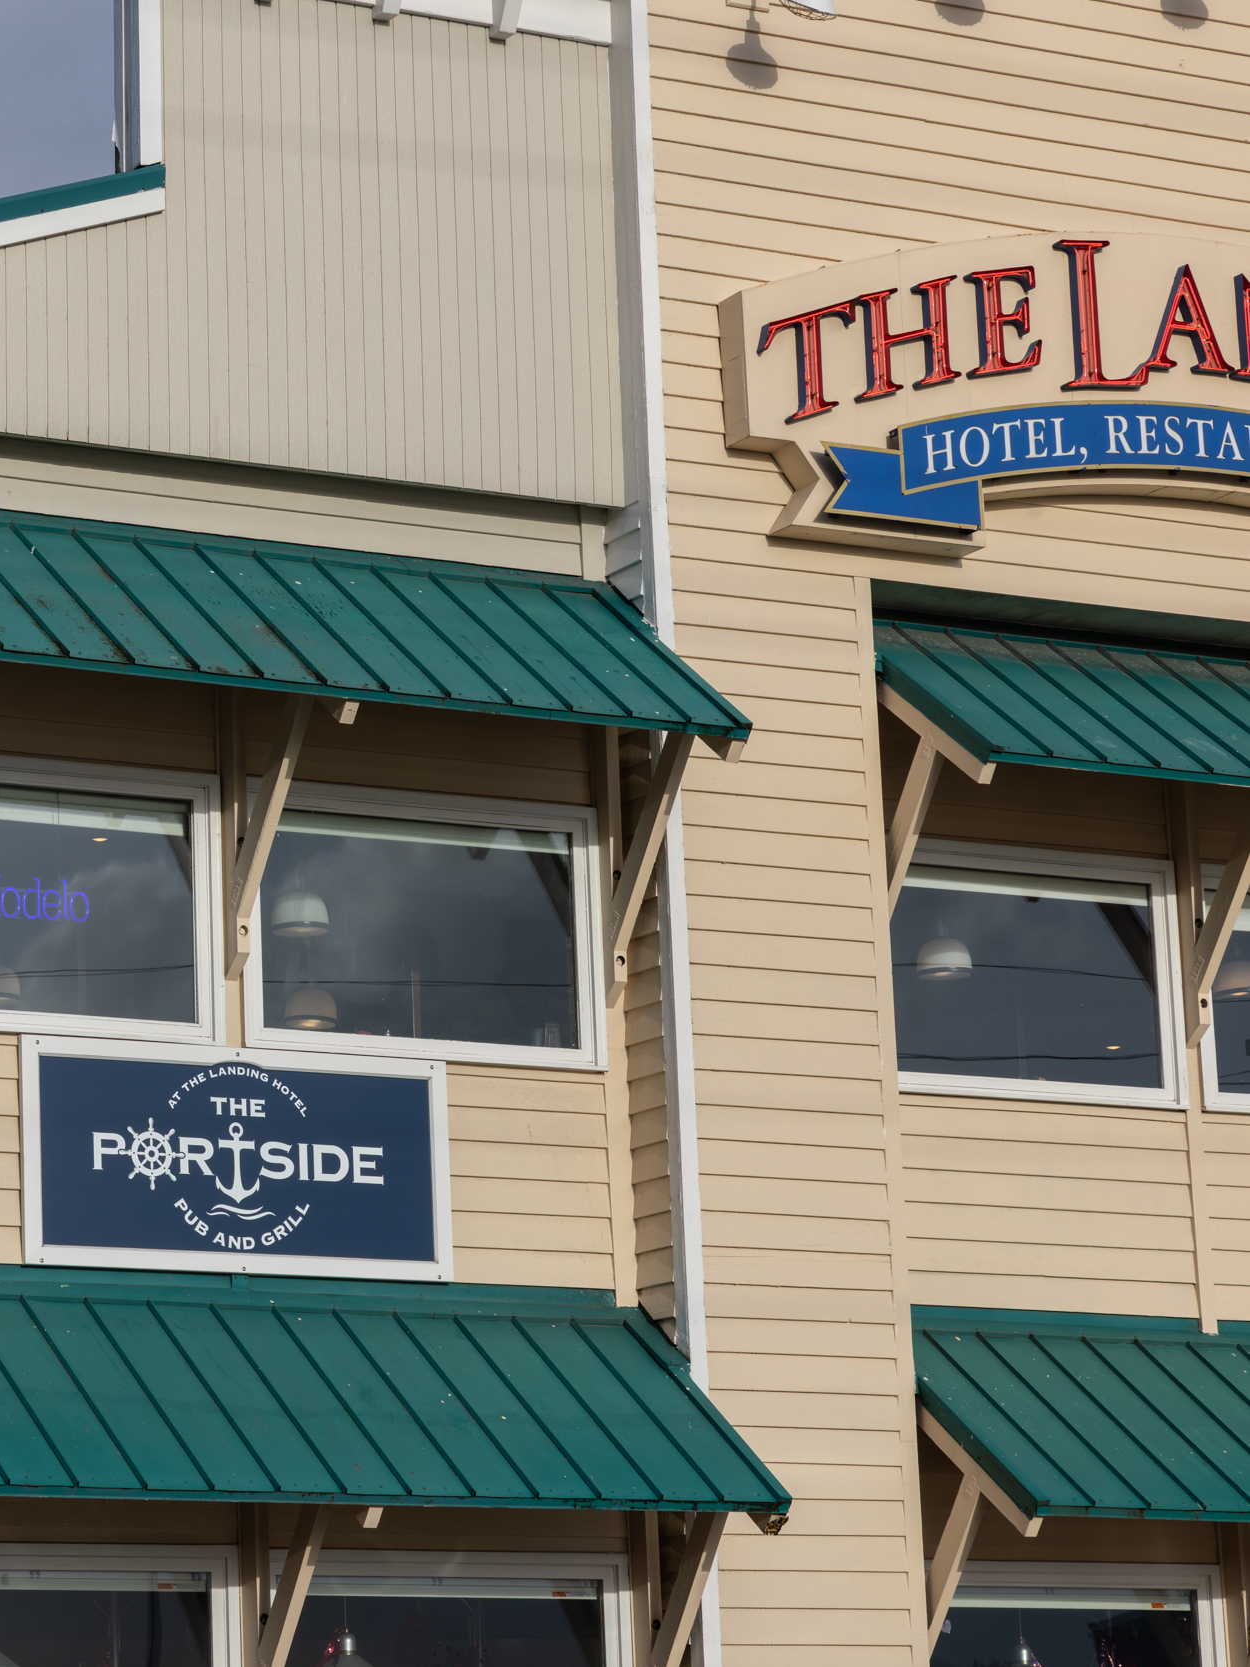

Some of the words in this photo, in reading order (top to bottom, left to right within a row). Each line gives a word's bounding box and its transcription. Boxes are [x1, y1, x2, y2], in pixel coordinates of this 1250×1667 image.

[756, 265, 1042, 424] THE
[1052, 240, 1250, 391] LA
[922, 417, 1088, 475] HOTEL,
[1103, 414, 1250, 461] RESTA
[167, 1091, 181, 1110] AT
[181, 1073, 208, 1093] THE
[209, 1066, 269, 1084] LANDING
[271, 1078, 307, 1118] HOTEL
[210, 1096, 266, 1118] THE
[92, 1117, 385, 1204] PORTSIDE
[173, 1197, 210, 1237] PUB
[212, 1231, 256, 1250] AND
[260, 1203, 311, 1247] GRILL
